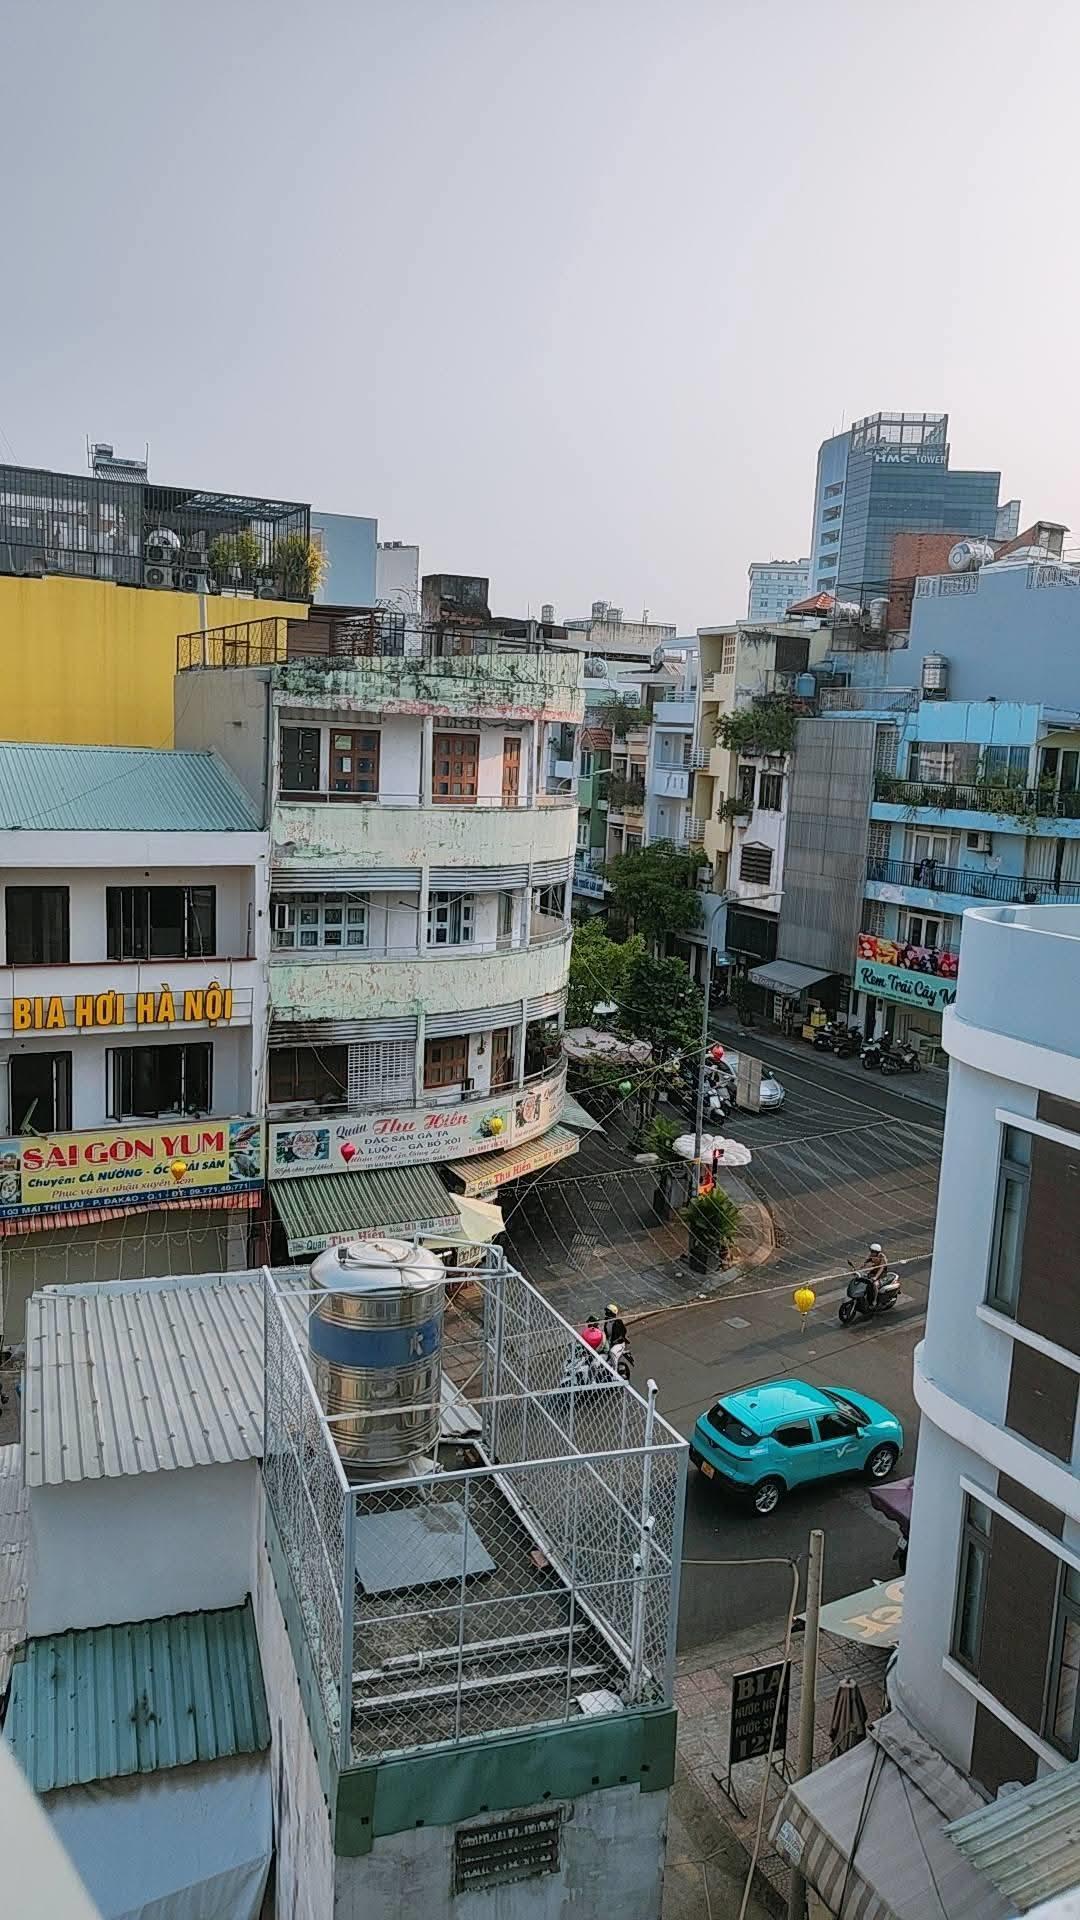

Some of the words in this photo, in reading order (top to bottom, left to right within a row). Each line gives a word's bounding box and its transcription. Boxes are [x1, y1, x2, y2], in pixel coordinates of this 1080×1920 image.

[875, 454, 910, 463] HMC
[916, 455, 945, 464] TOWER
[861, 967, 886, 988] Kem
[888, 973, 913, 994] Trái
[914, 980, 937, 1006] Cây
[13, 996, 67, 1030] BIA
[75, 989, 125, 1027] HƠI
[136, 983, 175, 1024] HÀ
[183, 980, 232, 1028] NỘI
[335, 1123, 368, 1140] Quán
[372, 1118, 416, 1135] Thu
[423, 1111, 471, 1131] Hiền
[365, 1136, 389, 1146] ĐẶC
[417, 1130, 433, 1140] GÀ
[436, 1130, 449, 1138] TA
[23, 1142, 78, 1171] SÀI
[84, 1136, 154, 1166] GÒN
[161, 1131, 224, 1157] YUM
[408, 1141, 426, 1151] GÀ
[444, 1136, 462, 1146] XÔI
[28, 1176, 76, 1189] Chuyên:
[97, 1167, 143, 1181] NƯỚNG
[153, 1162, 170, 1175] ỐC
[185, 1160, 200, 1172] ẢI
[201, 1158, 225, 1169] SẢN
[494, 1171, 511, 1184] Thu
[2, 1208, 19, 1216] 103
[22, 1205, 41, 1214] MAI
[42, 1203, 60, 1213] THỊ
[63, 1200, 84, 1210] LỰU
[93, 1199, 101, 1207] P.
[103, 1195, 139, 1205] ĐAKAO
[306, 1238, 327, 1250] Quán
[737, 1669, 781, 1702] BIA
